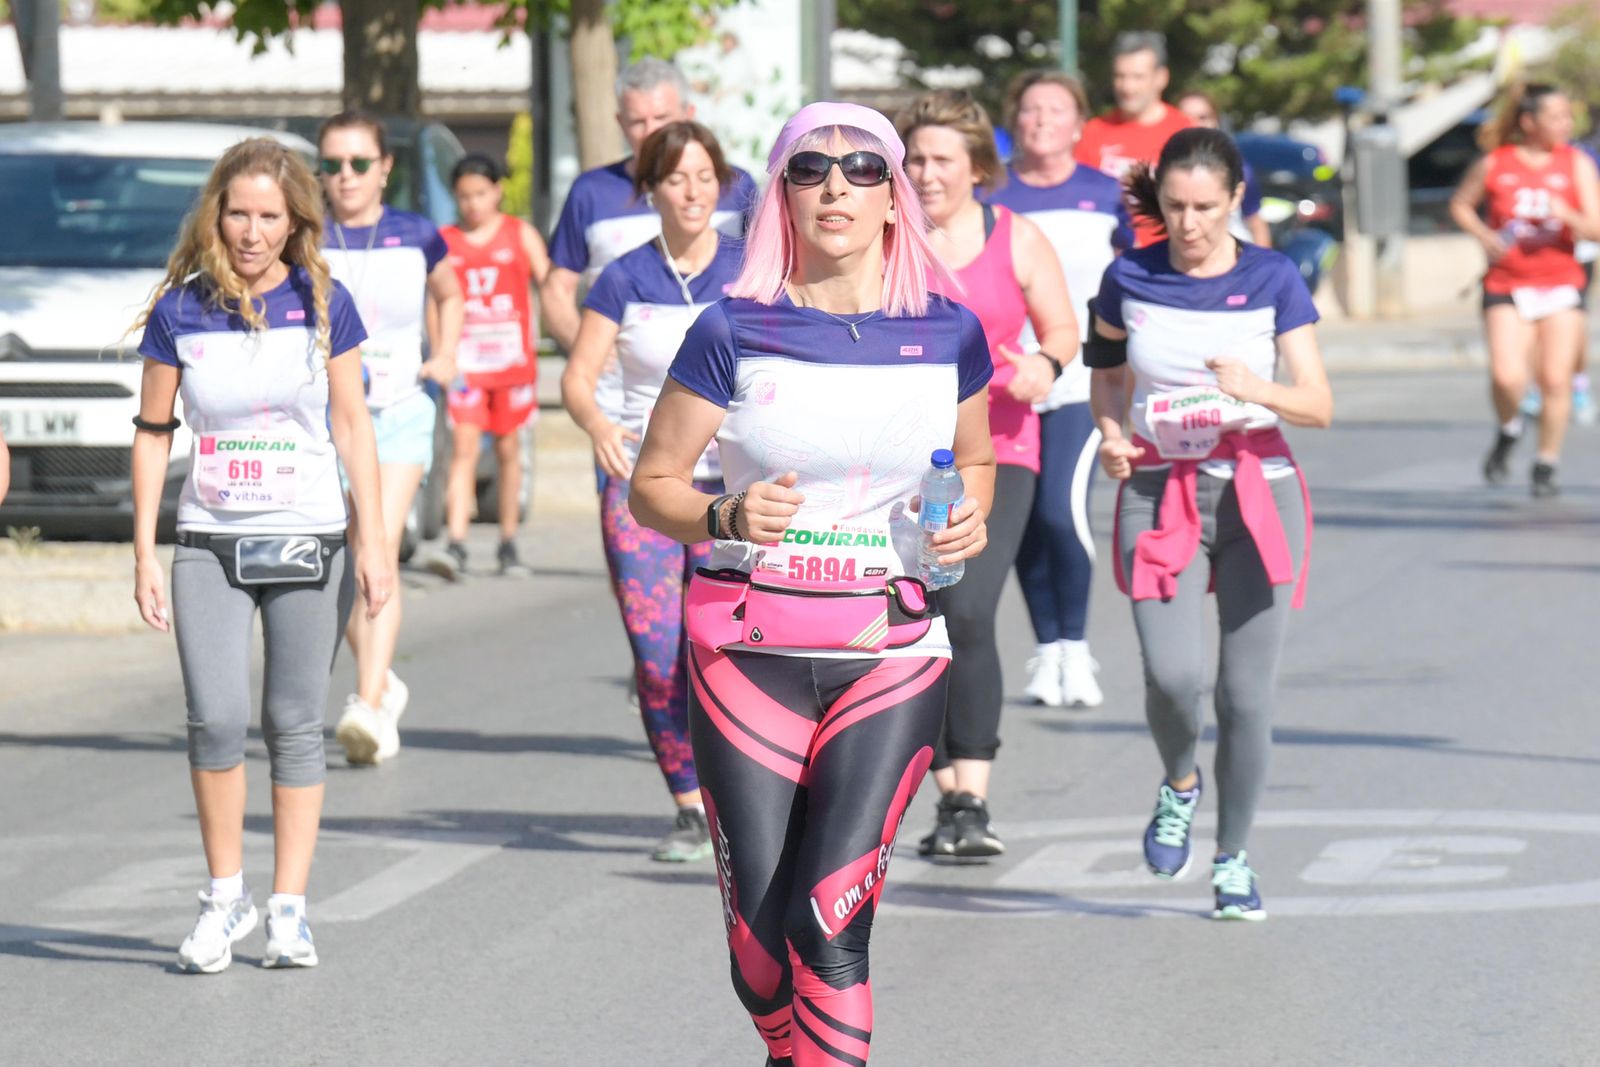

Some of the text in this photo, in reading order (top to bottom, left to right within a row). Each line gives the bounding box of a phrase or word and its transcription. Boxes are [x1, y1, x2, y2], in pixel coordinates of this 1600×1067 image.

[465, 266, 499, 296] 17
[1182, 407, 1221, 431] 1160
[228, 459, 262, 480] 619
[234, 490, 273, 501] vithas
[788, 555, 857, 582] 5894
[834, 884, 863, 920] am
[864, 871, 876, 891] a
